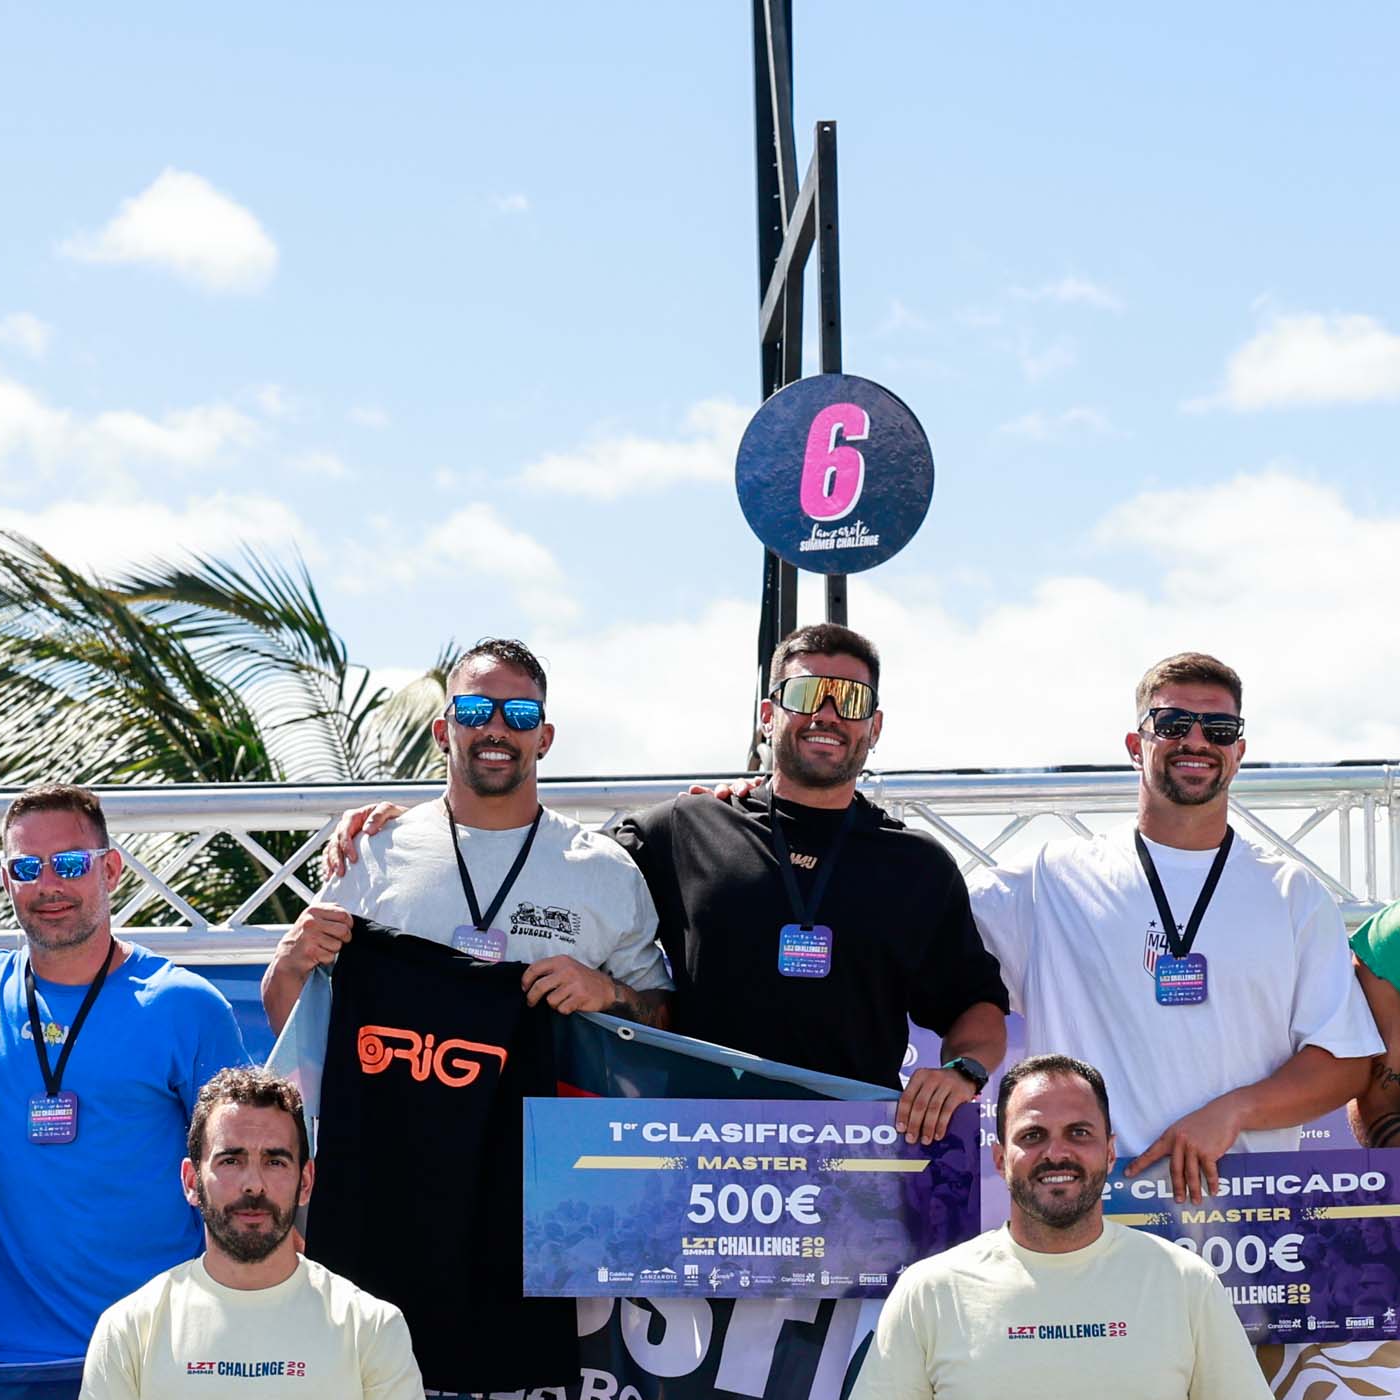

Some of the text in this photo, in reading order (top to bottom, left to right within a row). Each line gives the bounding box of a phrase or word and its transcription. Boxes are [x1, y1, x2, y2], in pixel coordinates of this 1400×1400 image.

[800, 402, 870, 522] 6
[800, 534, 880, 552] SUMMER CHALLENGE
[642, 1122, 898, 1145] CLASIFICADO
[697, 1156, 808, 1171] MASTER
[686, 1183, 822, 1225] 500€
[1181, 1207, 1290, 1225] MASTER
[681, 1237, 717, 1248] LZT
[718, 1236, 800, 1256] CHALLENGE
[1174, 1233, 1306, 1275] 00€
[1008, 1326, 1037, 1335] LZT
[1038, 1323, 1107, 1340] CHALLENGE
[186, 1361, 217, 1370] LZT
[217, 1360, 286, 1378] CHALLENGE
